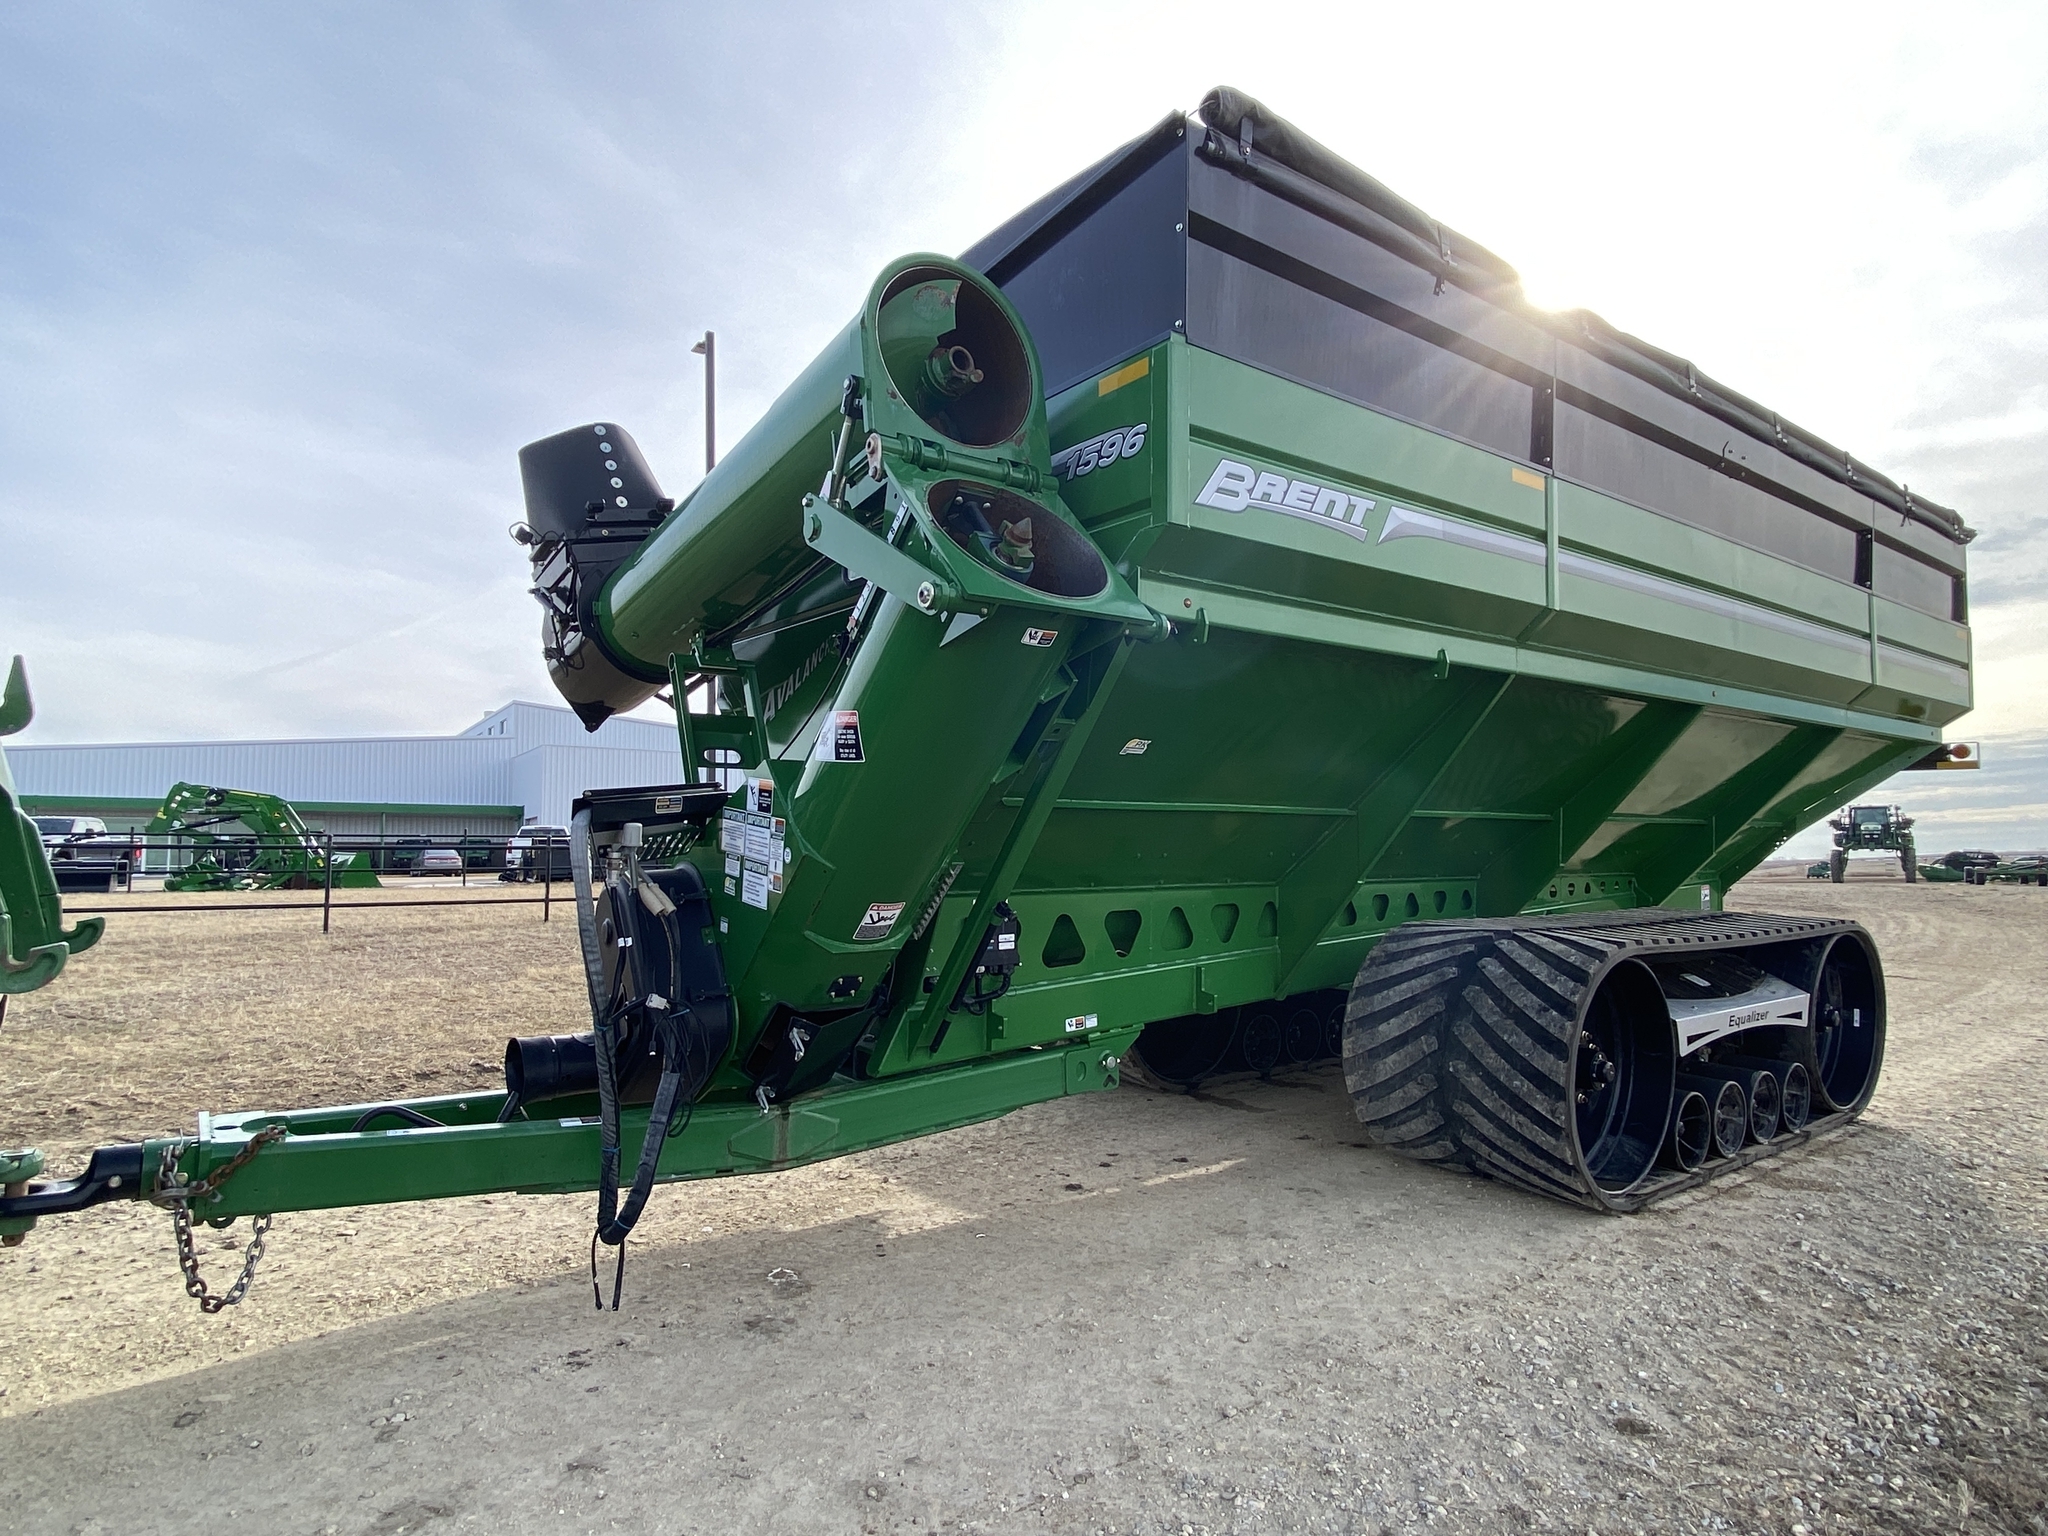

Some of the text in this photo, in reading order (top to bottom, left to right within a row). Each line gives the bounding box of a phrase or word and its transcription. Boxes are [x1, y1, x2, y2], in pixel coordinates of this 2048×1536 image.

[1066, 422, 1148, 481] 1596
[1194, 458, 1376, 528] BRENT
[763, 633, 838, 724] AVALANCH
[1728, 1011, 1769, 1028] Equalizer
